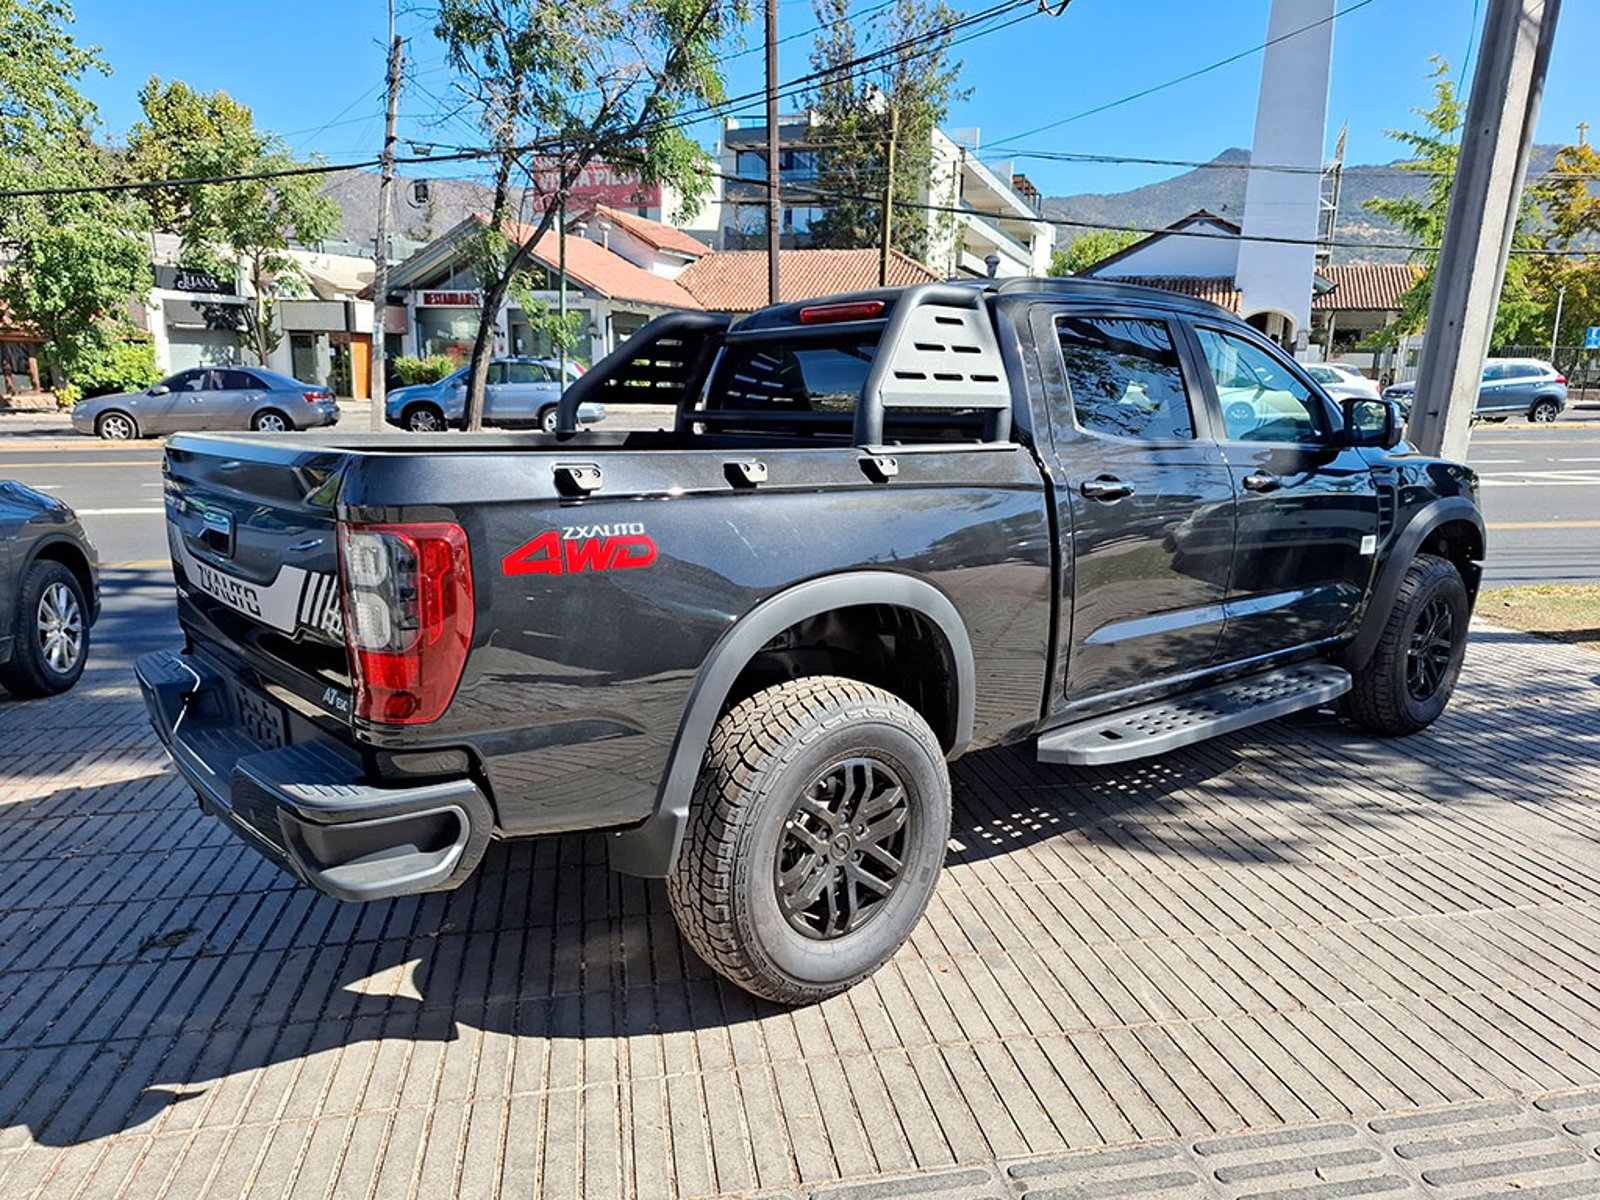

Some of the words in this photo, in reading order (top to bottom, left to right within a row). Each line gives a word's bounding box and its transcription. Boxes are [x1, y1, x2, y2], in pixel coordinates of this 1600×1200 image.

[501, 530, 658, 576] 4WD
[562, 521, 645, 540] ZXAUTO
[196, 564, 262, 617] ZXAUTO
